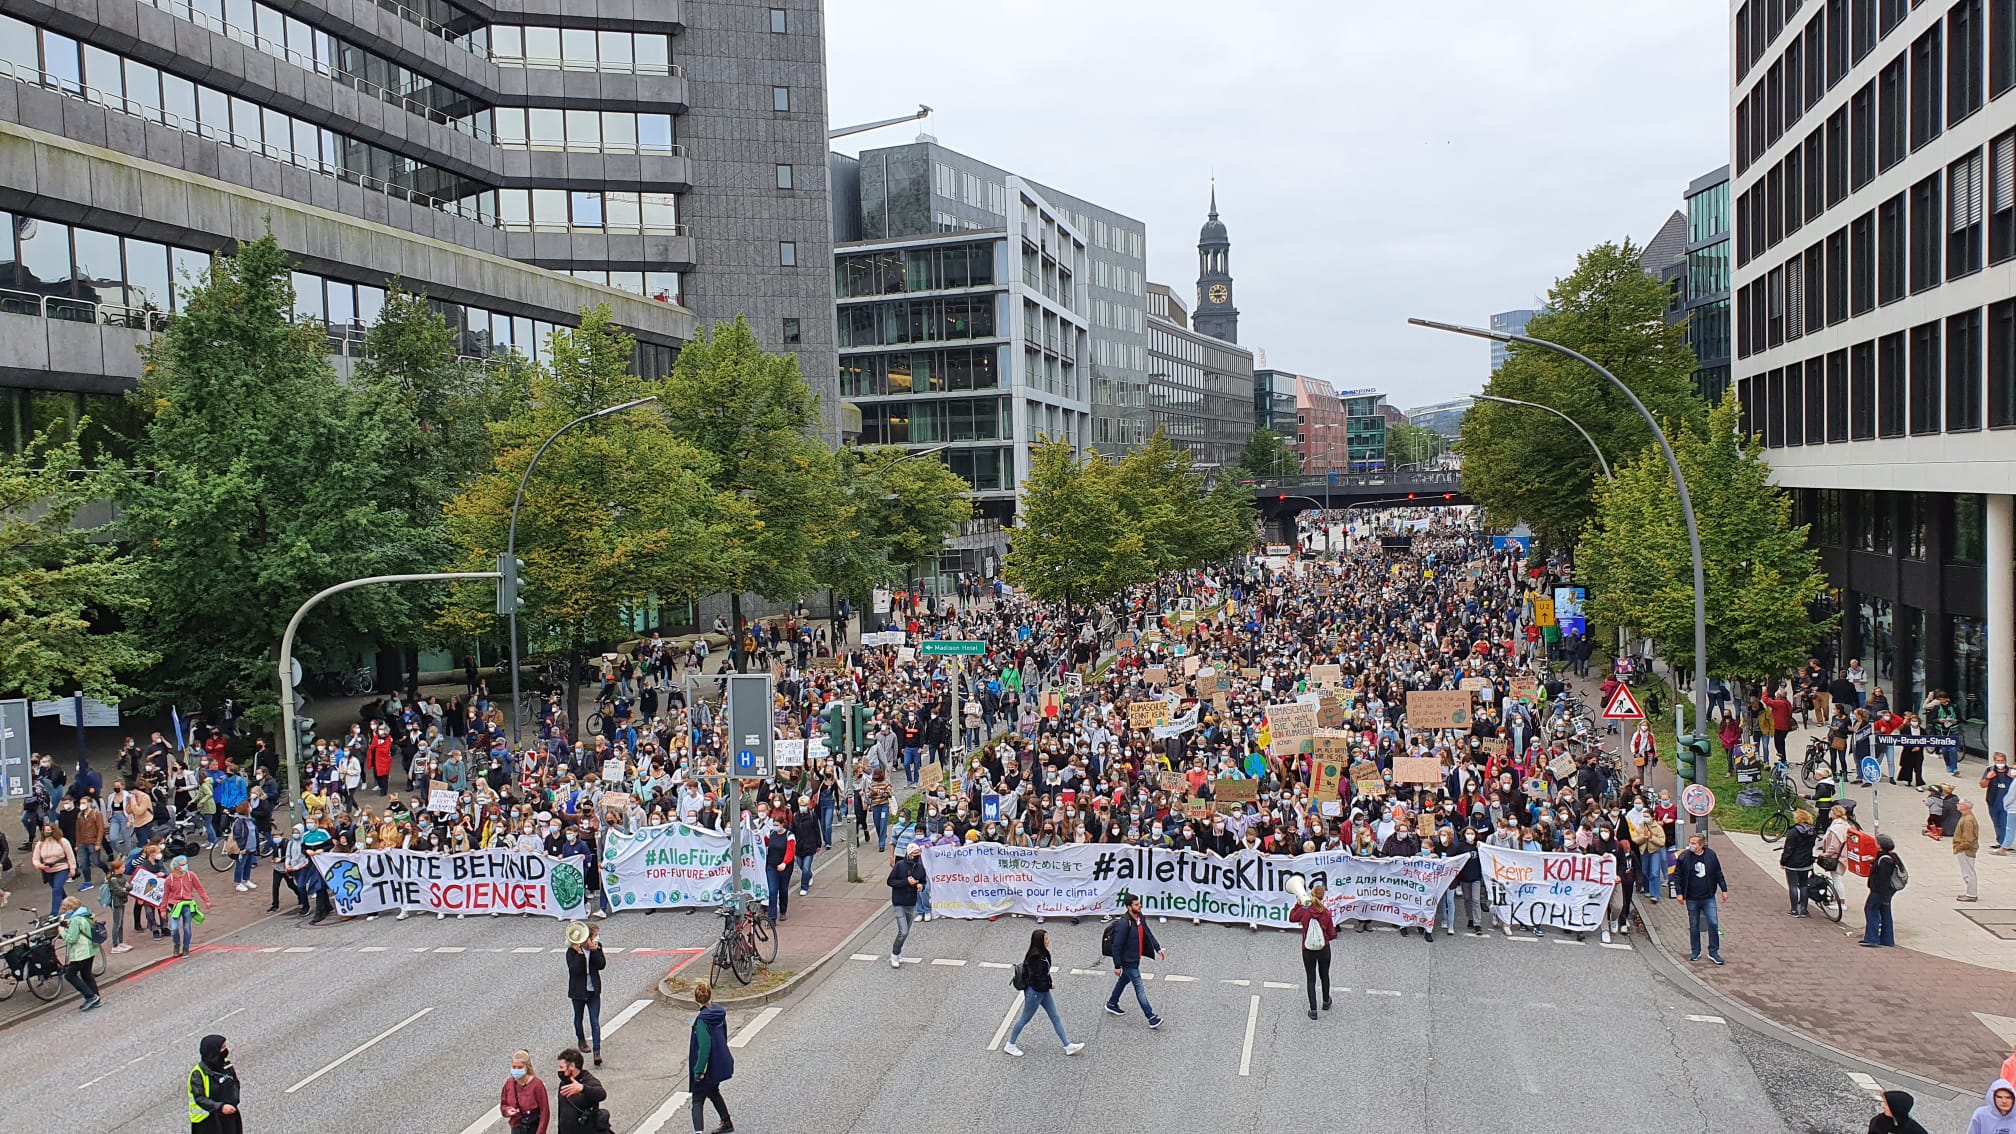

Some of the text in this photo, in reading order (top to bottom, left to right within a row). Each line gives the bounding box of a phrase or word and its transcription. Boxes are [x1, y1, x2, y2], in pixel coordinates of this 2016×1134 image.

[934, 644, 978, 652] Madison Hotel
[1131, 712, 1149, 720] KENNT
[1274, 720, 1313, 731] DIE WELT
[1286, 728, 1316, 737] KLIMASCHUT
[1878, 735, 1957, 747] Willy-Brandt-Straße
[366, 853, 546, 881] UNITE BEHIND
[1492, 855, 1614, 885] keine KOHLE
[973, 873, 989, 883] dla
[992, 872, 1033, 883] klimatu
[1356, 875, 1376, 884] для
[1380, 875, 1425, 892] климата
[373, 880, 421, 905] THE
[429, 881, 547, 911] SCIENCE!
[970, 886, 1098, 899] ensemble pour le climat
[1550, 882, 1573, 896] die
[1357, 886, 1437, 907] unidos por el cli
[1115, 887, 1290, 921] #unitedforclimat
[1340, 904, 1358, 915] per
[1370, 903, 1400, 915] clima
[1511, 901, 1601, 927] KOHLE
